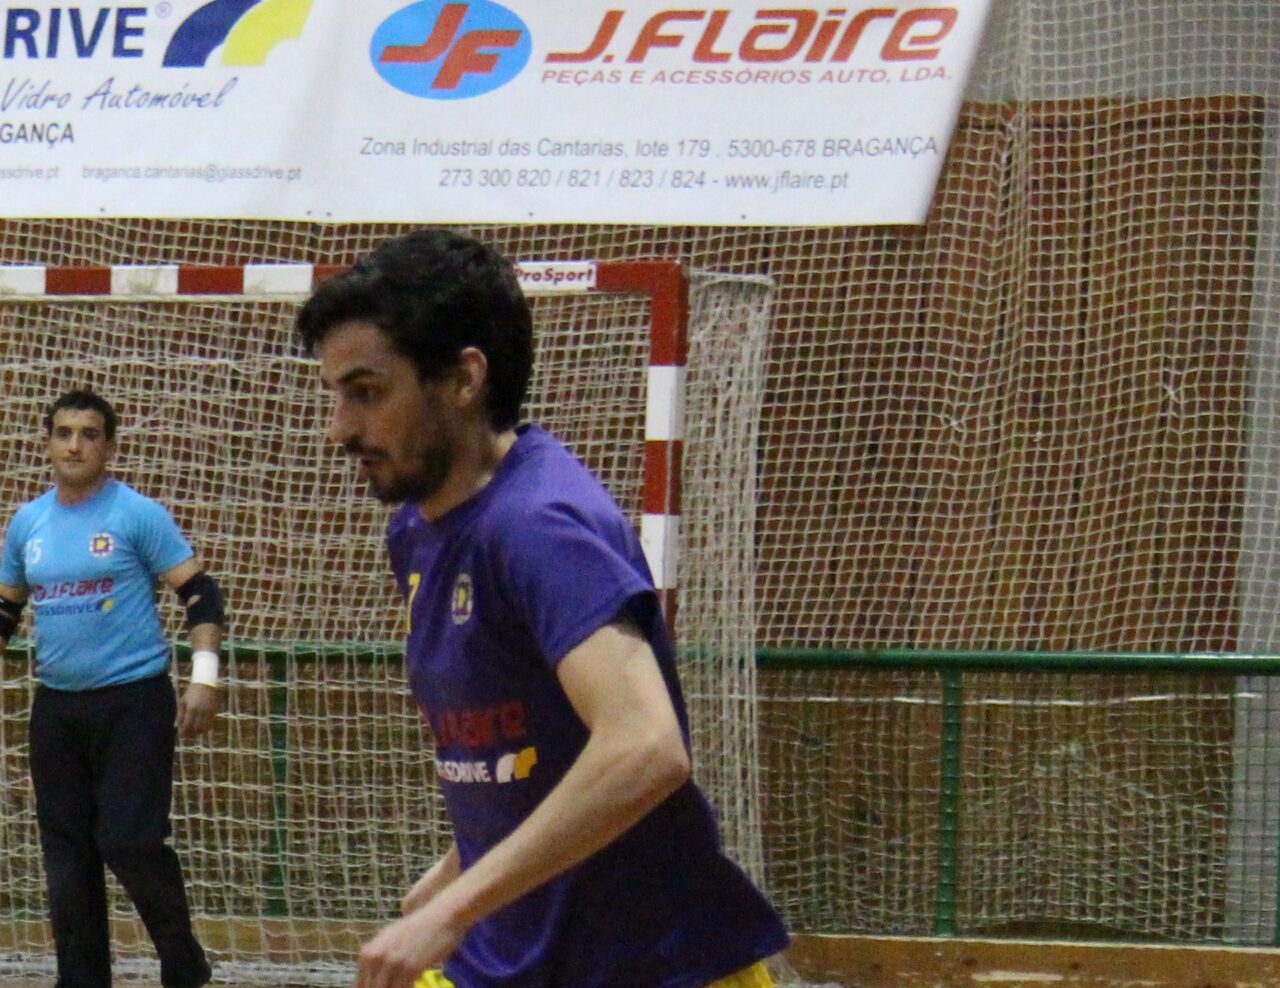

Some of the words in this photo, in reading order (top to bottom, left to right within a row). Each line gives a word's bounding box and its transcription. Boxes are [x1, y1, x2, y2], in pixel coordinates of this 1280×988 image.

[541, 69, 622, 86] PEÇAS
[629, 70, 644, 84] E
[651, 66, 812, 84] ACESSÓRIOS
[900, 67, 952, 82] LDA.
[0, 76, 72, 111] Vidro
[81, 75, 238, 111] Automóvel
[360, 137, 407, 157] Zona
[413, 137, 493, 157] Industrial
[499, 137, 531, 157] das
[635, 137, 669, 157] lote
[677, 138, 711, 158] 179
[727, 138, 816, 158] 5300-678
[823, 136, 939, 160] BRAGANÇA
[439, 168, 473, 187] 273
[478, 168, 512, 187] 300
[516, 168, 551, 187] 820
[568, 169, 600, 187] 821
[620, 169, 653, 188] 823
[671, 169, 705, 188] 824
[725, 169, 849, 193] www.jflaire.pt
